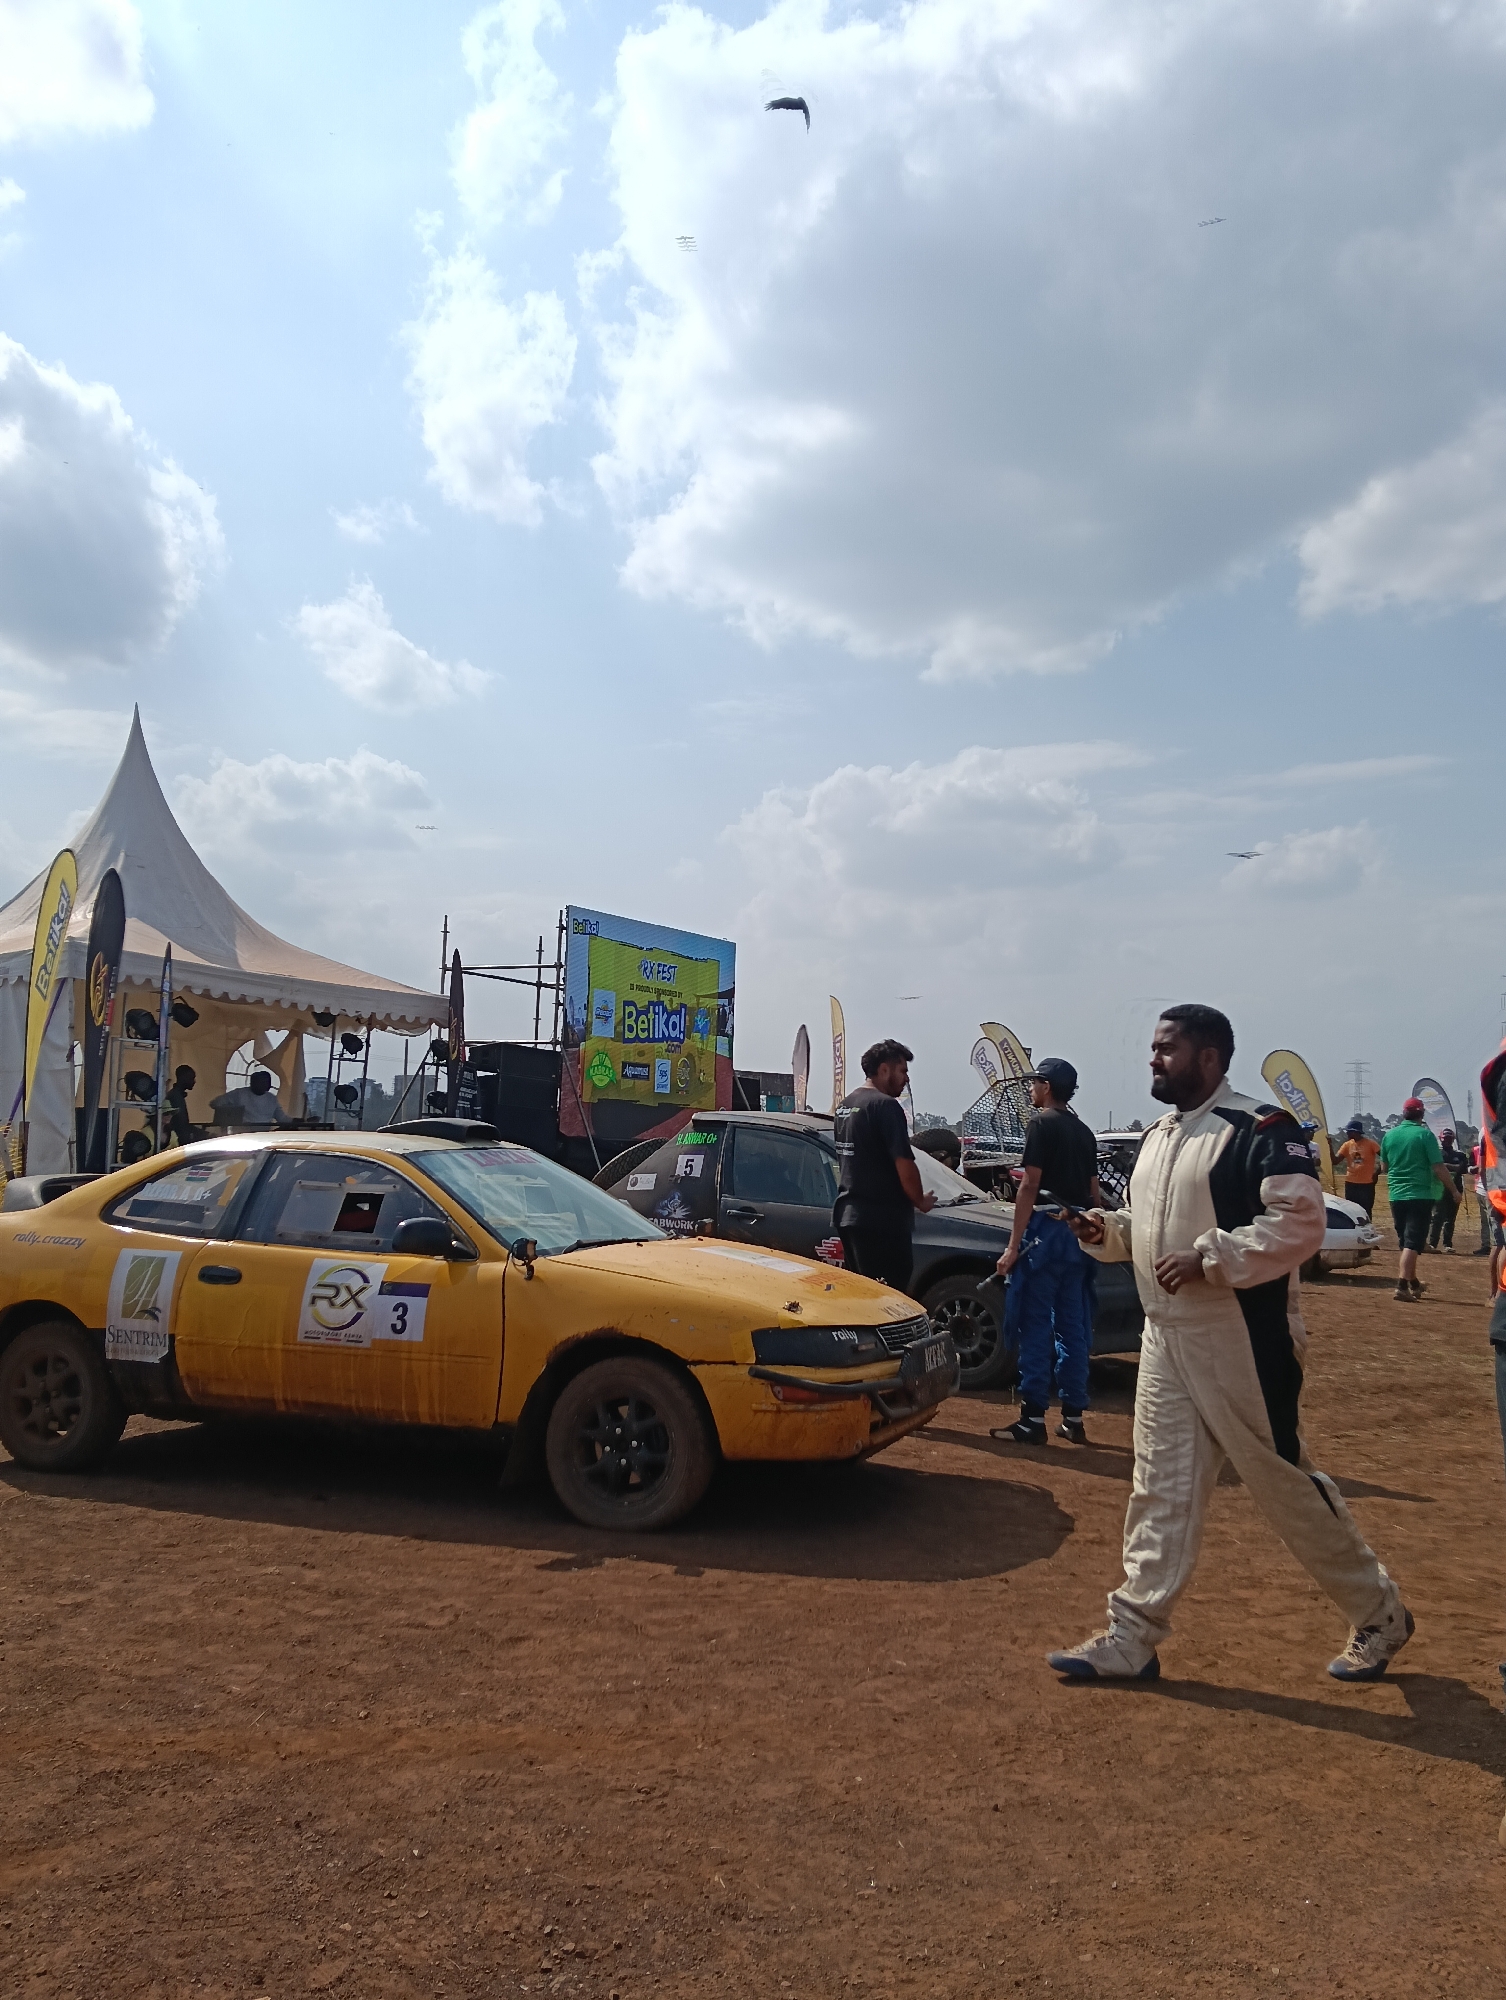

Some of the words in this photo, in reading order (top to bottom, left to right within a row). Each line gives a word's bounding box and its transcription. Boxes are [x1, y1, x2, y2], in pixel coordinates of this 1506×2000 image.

[573, 919, 599, 935] Betika!
[656, 962, 678, 984] FEST
[624, 1002, 686, 1041] Betika!
[683, 1158, 695, 1176] 5
[308, 1280, 373, 1312] RX
[390, 1301, 409, 1335] 3
[107, 1324, 168, 1348] SENTRIM
[831, 1328, 858, 1344] rally
